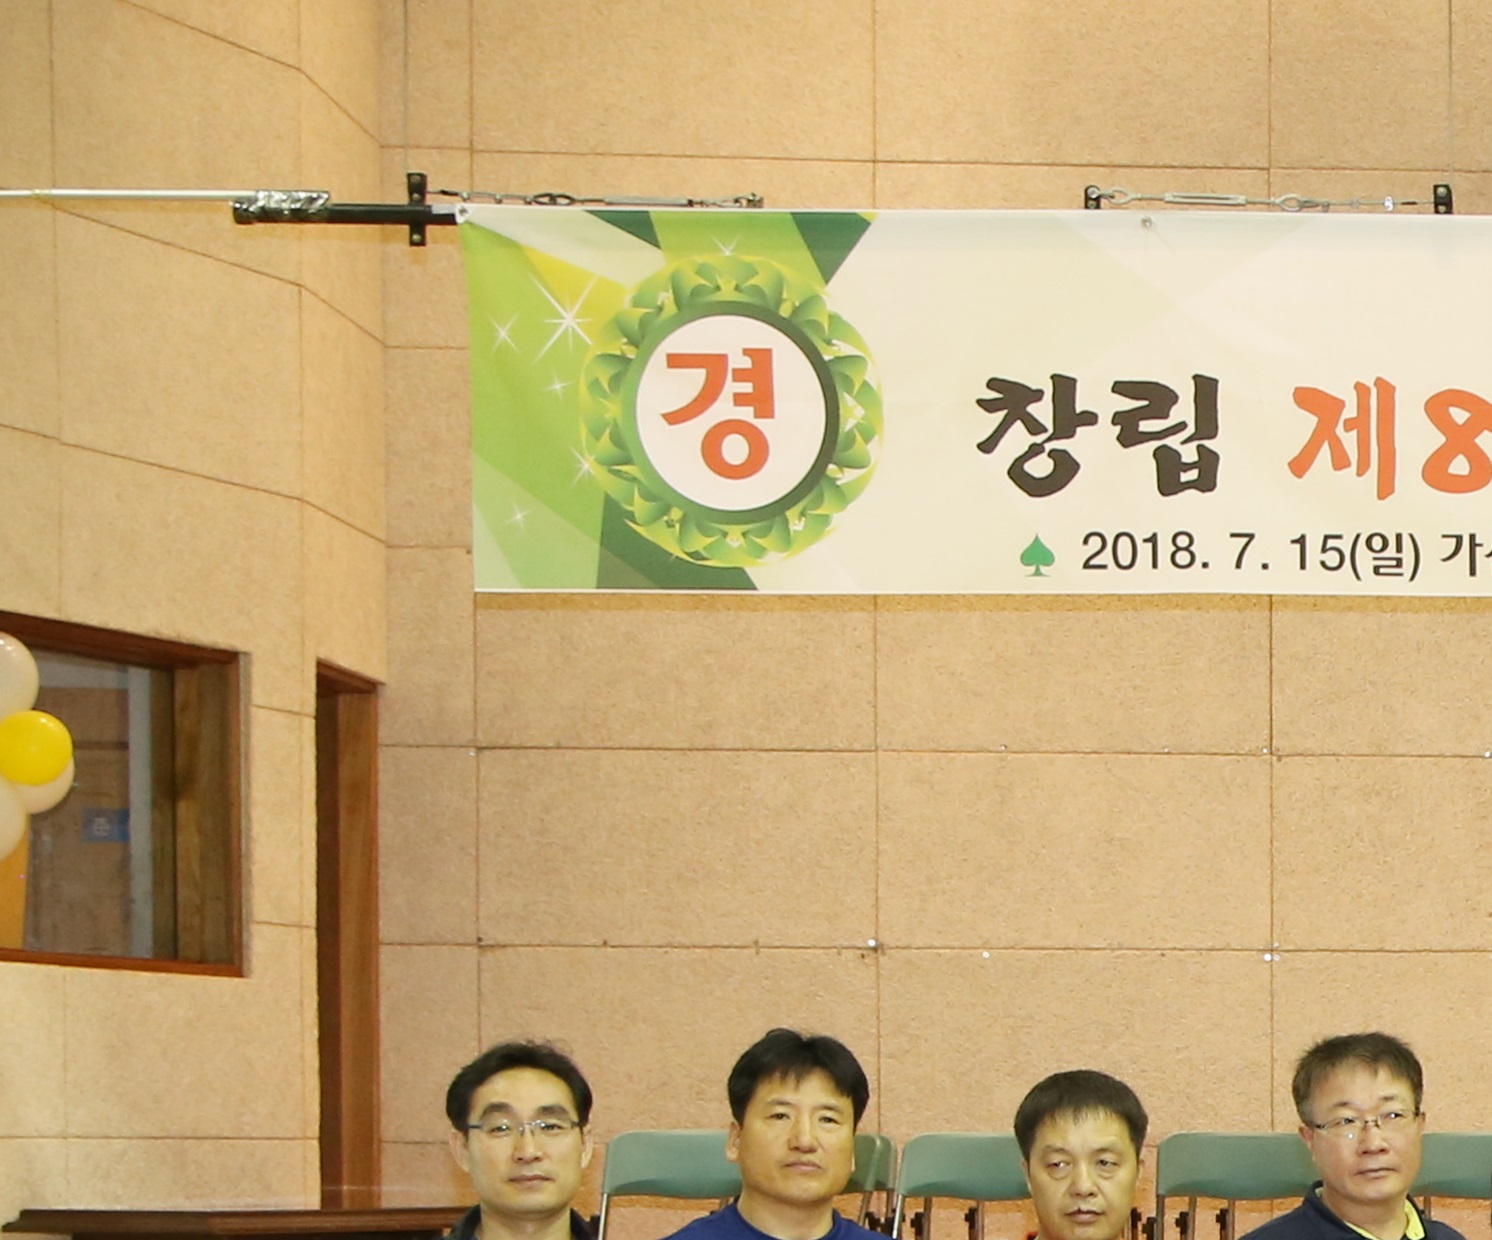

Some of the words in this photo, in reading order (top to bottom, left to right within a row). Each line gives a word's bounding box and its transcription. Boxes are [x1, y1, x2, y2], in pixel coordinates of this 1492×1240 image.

[660, 347, 781, 480] 경
[976, 374, 1220, 498] 창립
[1082, 531, 1210, 571] 2018.
[1230, 532, 1269, 570] 7.
[1291, 532, 1421, 581] 15(일)
